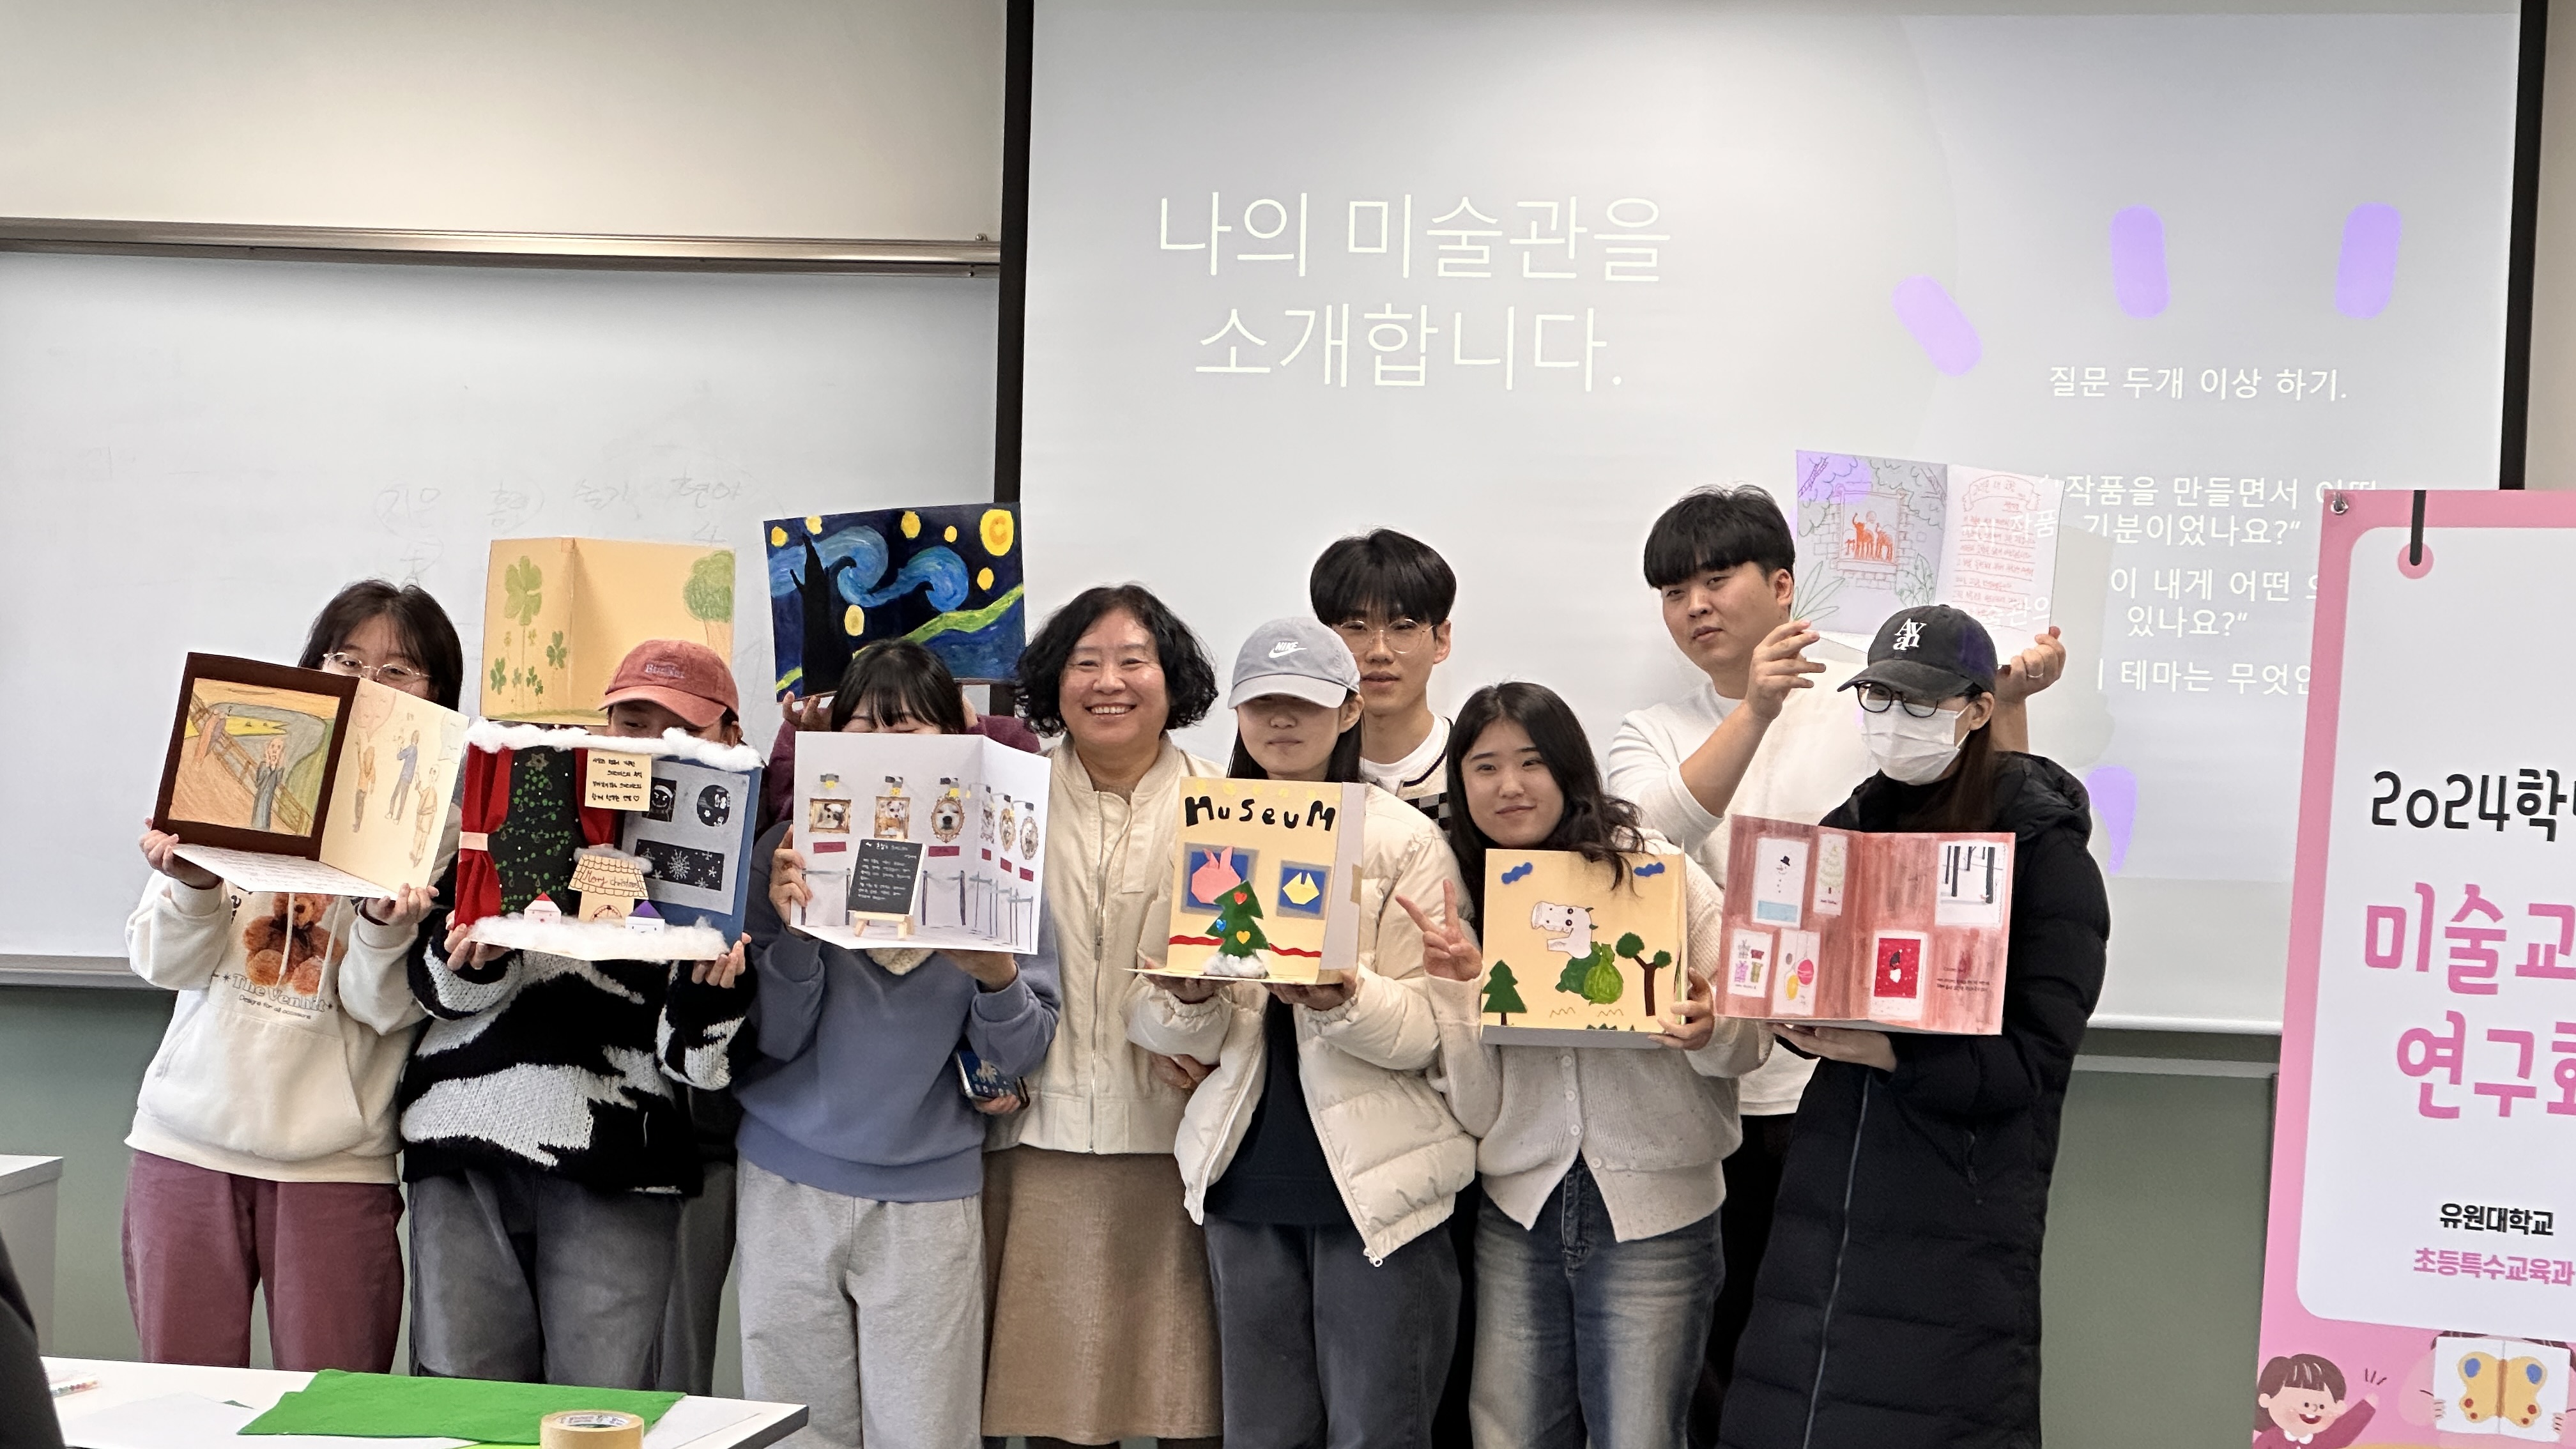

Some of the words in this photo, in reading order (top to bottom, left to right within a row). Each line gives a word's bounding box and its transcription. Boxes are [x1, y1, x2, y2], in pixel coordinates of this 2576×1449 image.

[1160, 192, 1307, 277] 나의
[1348, 194, 1671, 282] 미술관을
[1195, 303, 1622, 392] 소개합니다.
[2049, 366, 2110, 397] 질문
[2122, 367, 2184, 400] 두개
[2200, 367, 2262, 401] 이상
[2276, 368, 2347, 402] 하기.
[2066, 475, 2159, 507] 작품을
[2173, 477, 2299, 509] 만들면서
[2154, 568, 2214, 601] 내게
[2230, 570, 2290, 602] 어떤
[1275, 641, 1299, 652] NIKE
[2120, 659, 2214, 693] 테마는
[2372, 768, 2576, 843] 2024학
[582, 870, 608, 887] Merry
[232, 974, 266, 997] The
[2439, 1201, 2555, 1237] 유원대학교
[2412, 1246, 2576, 1287] 초등특수교육과
